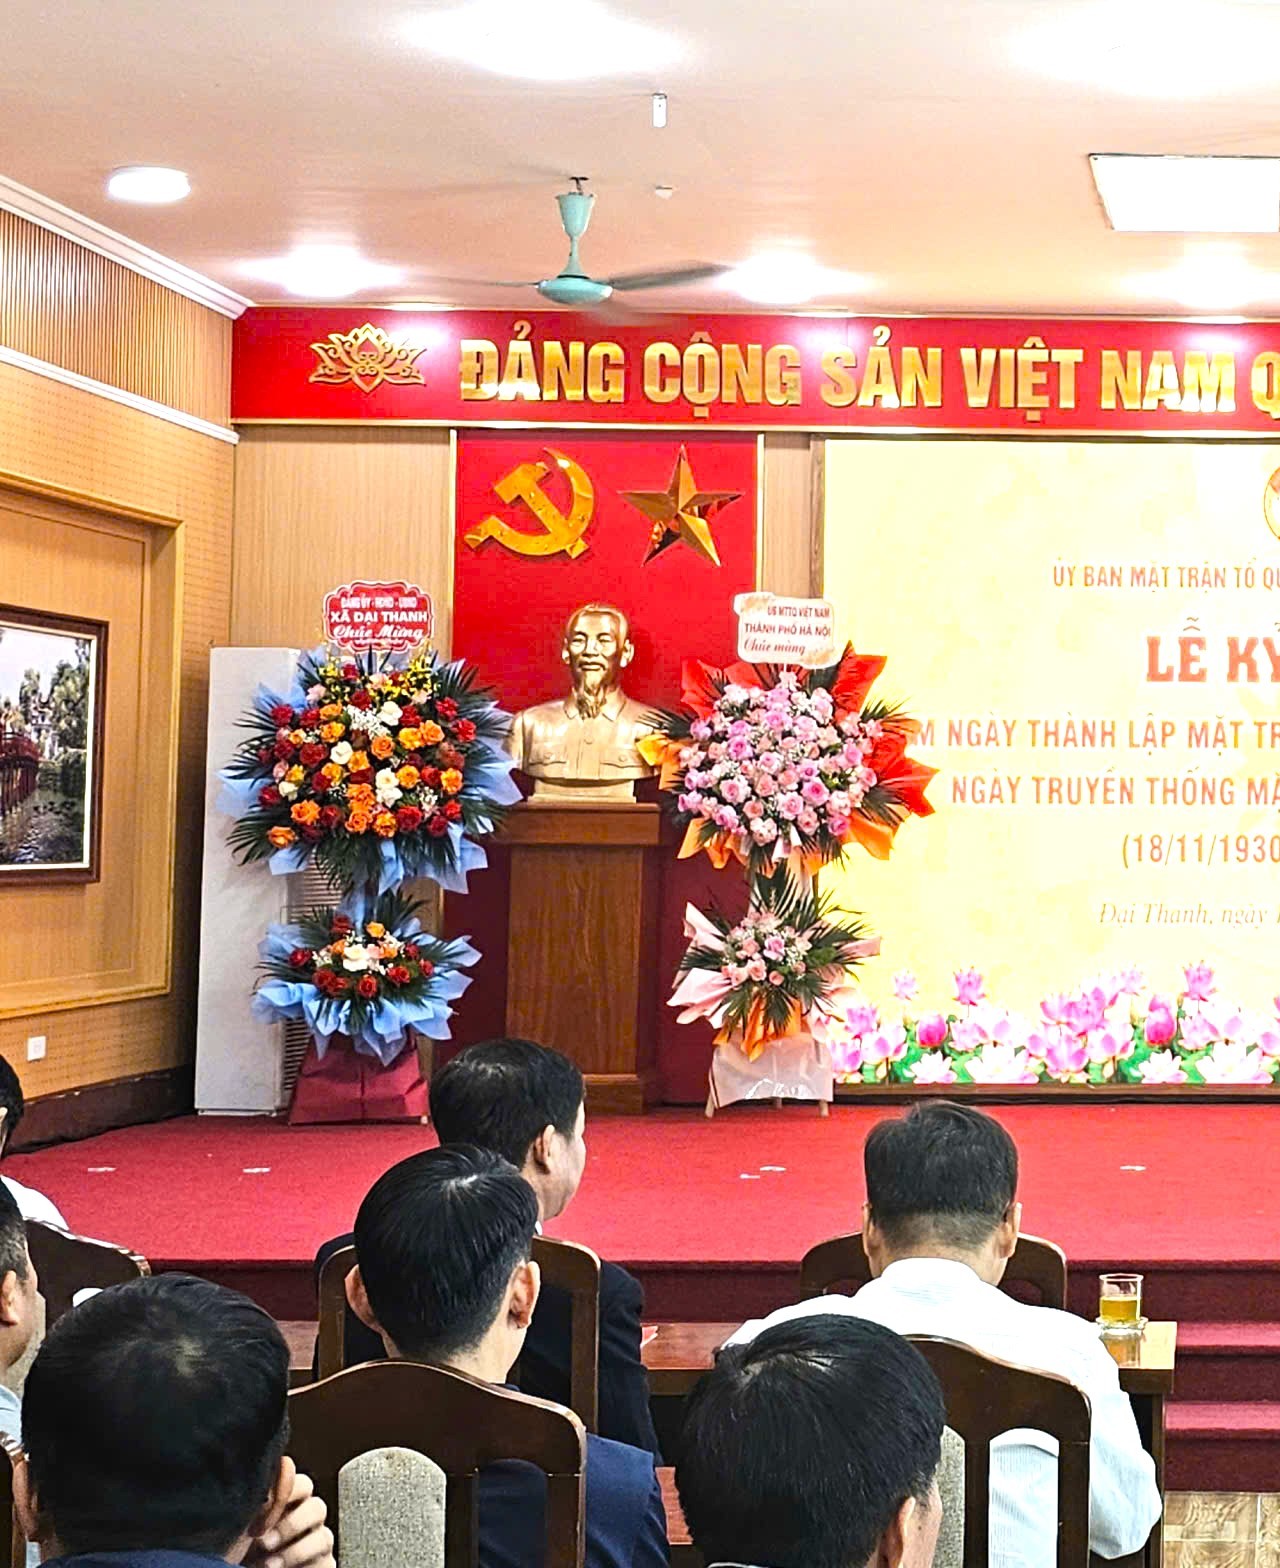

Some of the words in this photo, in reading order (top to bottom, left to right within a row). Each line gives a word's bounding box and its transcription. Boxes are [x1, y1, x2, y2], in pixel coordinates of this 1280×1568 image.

[459, 319, 622, 403] ĐẢNG
[644, 332, 802, 418] CỘNG
[820, 325, 942, 410] SẢN
[959, 335, 1084, 421] VIỆT
[1101, 349, 1237, 413] NAM
[1053, 557, 1076, 588] ỦY
[1083, 566, 1123, 588] BAN
[1130, 561, 1170, 593] MẶT
[1178, 561, 1227, 594] TRẬN
[1234, 557, 1257, 589] TỔ
[330, 609, 351, 622] XÃ
[381, 611, 428, 622] THANH
[814, 607, 830, 617] NAM
[333, 625, 373, 638] Chúc
[376, 624, 424, 640] Mừng
[744, 621, 776, 634] THÀNH
[778, 621, 798, 636] PHỐ
[799, 623, 813, 636] HÀ
[815, 623, 832, 640] NỘI
[744, 638, 771, 652] Chúc
[1146, 616, 1208, 683] LỄ
[948, 711, 1018, 748] NGÀY
[1027, 711, 1117, 749] THÀNH
[1128, 712, 1177, 756] LẬP
[1187, 714, 1245, 757] MẶT
[952, 767, 1022, 804] NGÀY
[1031, 766, 1135, 805] TRUYỀN
[1146, 766, 1236, 806] THỐNG
